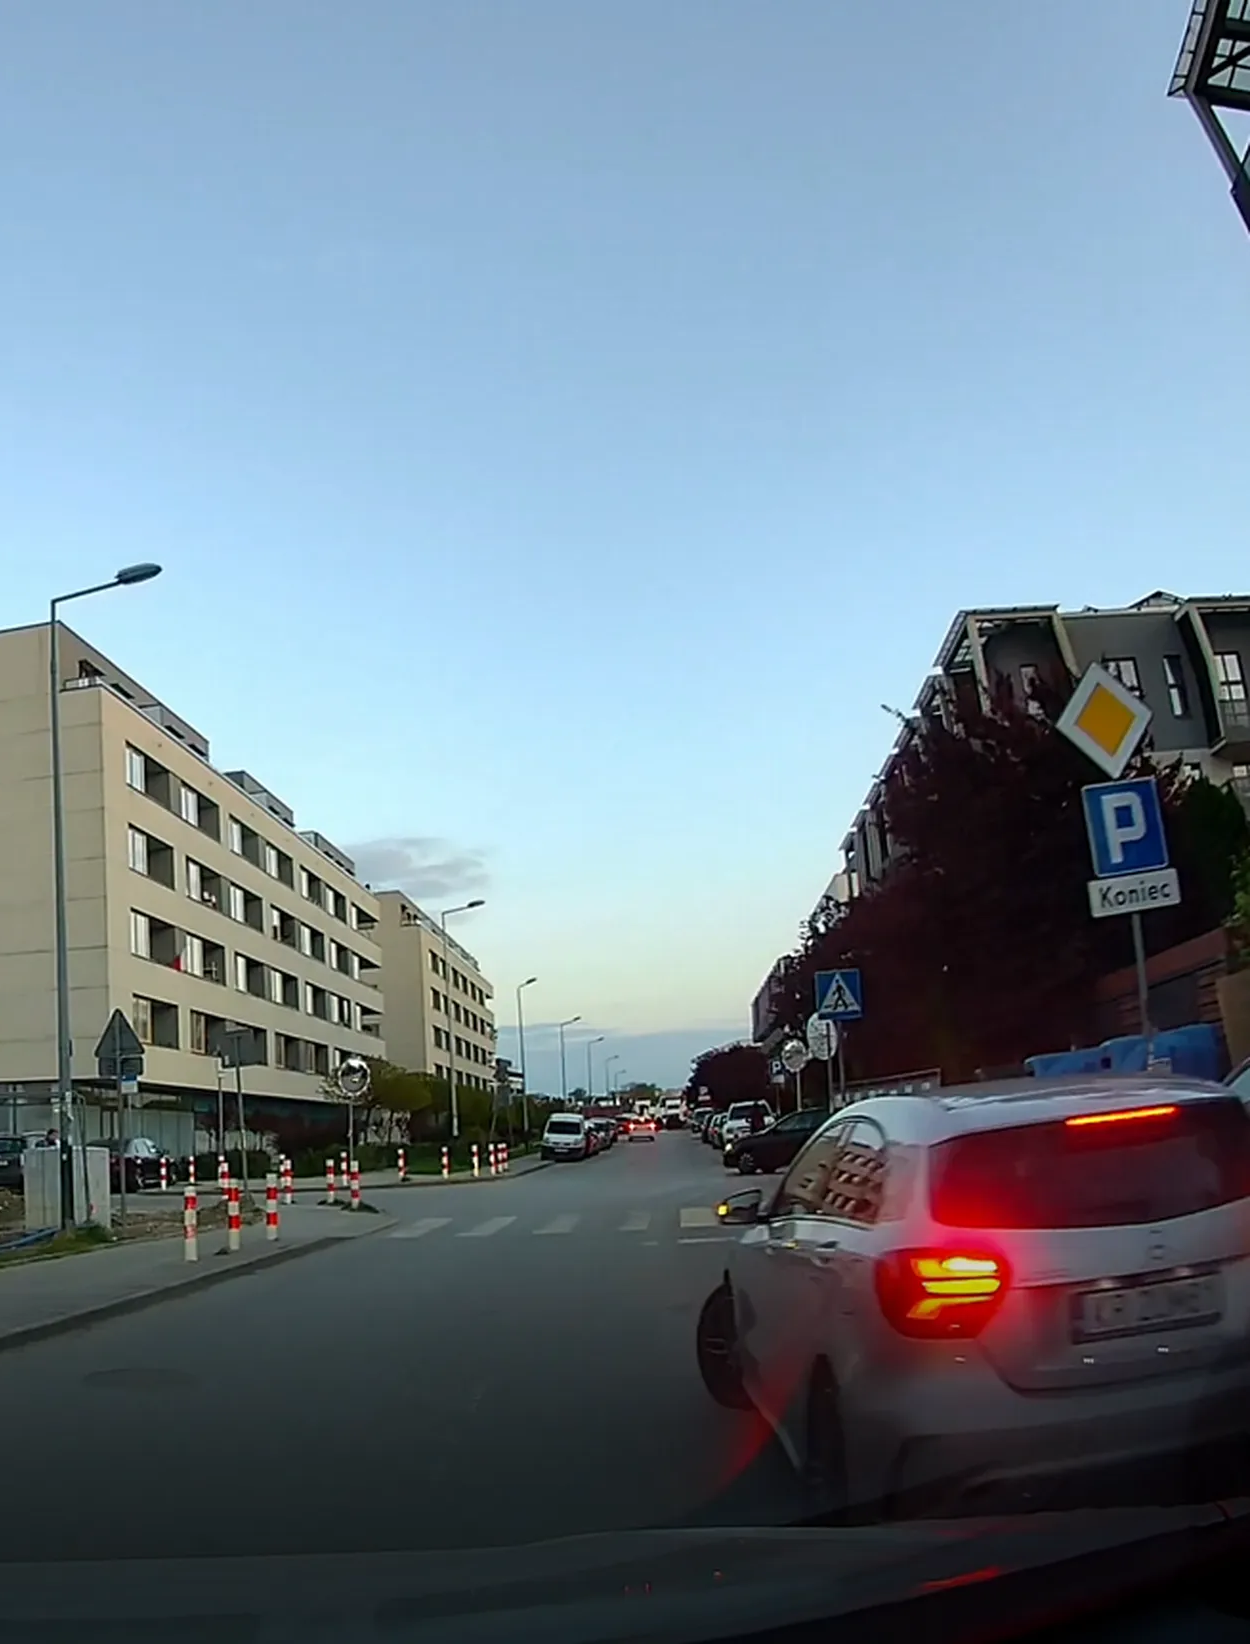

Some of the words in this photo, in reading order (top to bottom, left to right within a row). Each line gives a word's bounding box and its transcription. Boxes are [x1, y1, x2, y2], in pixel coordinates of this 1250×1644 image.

[1101, 791, 1146, 864] P
[1100, 880, 1171, 908] Koniec
[772, 1061, 781, 1073] P
